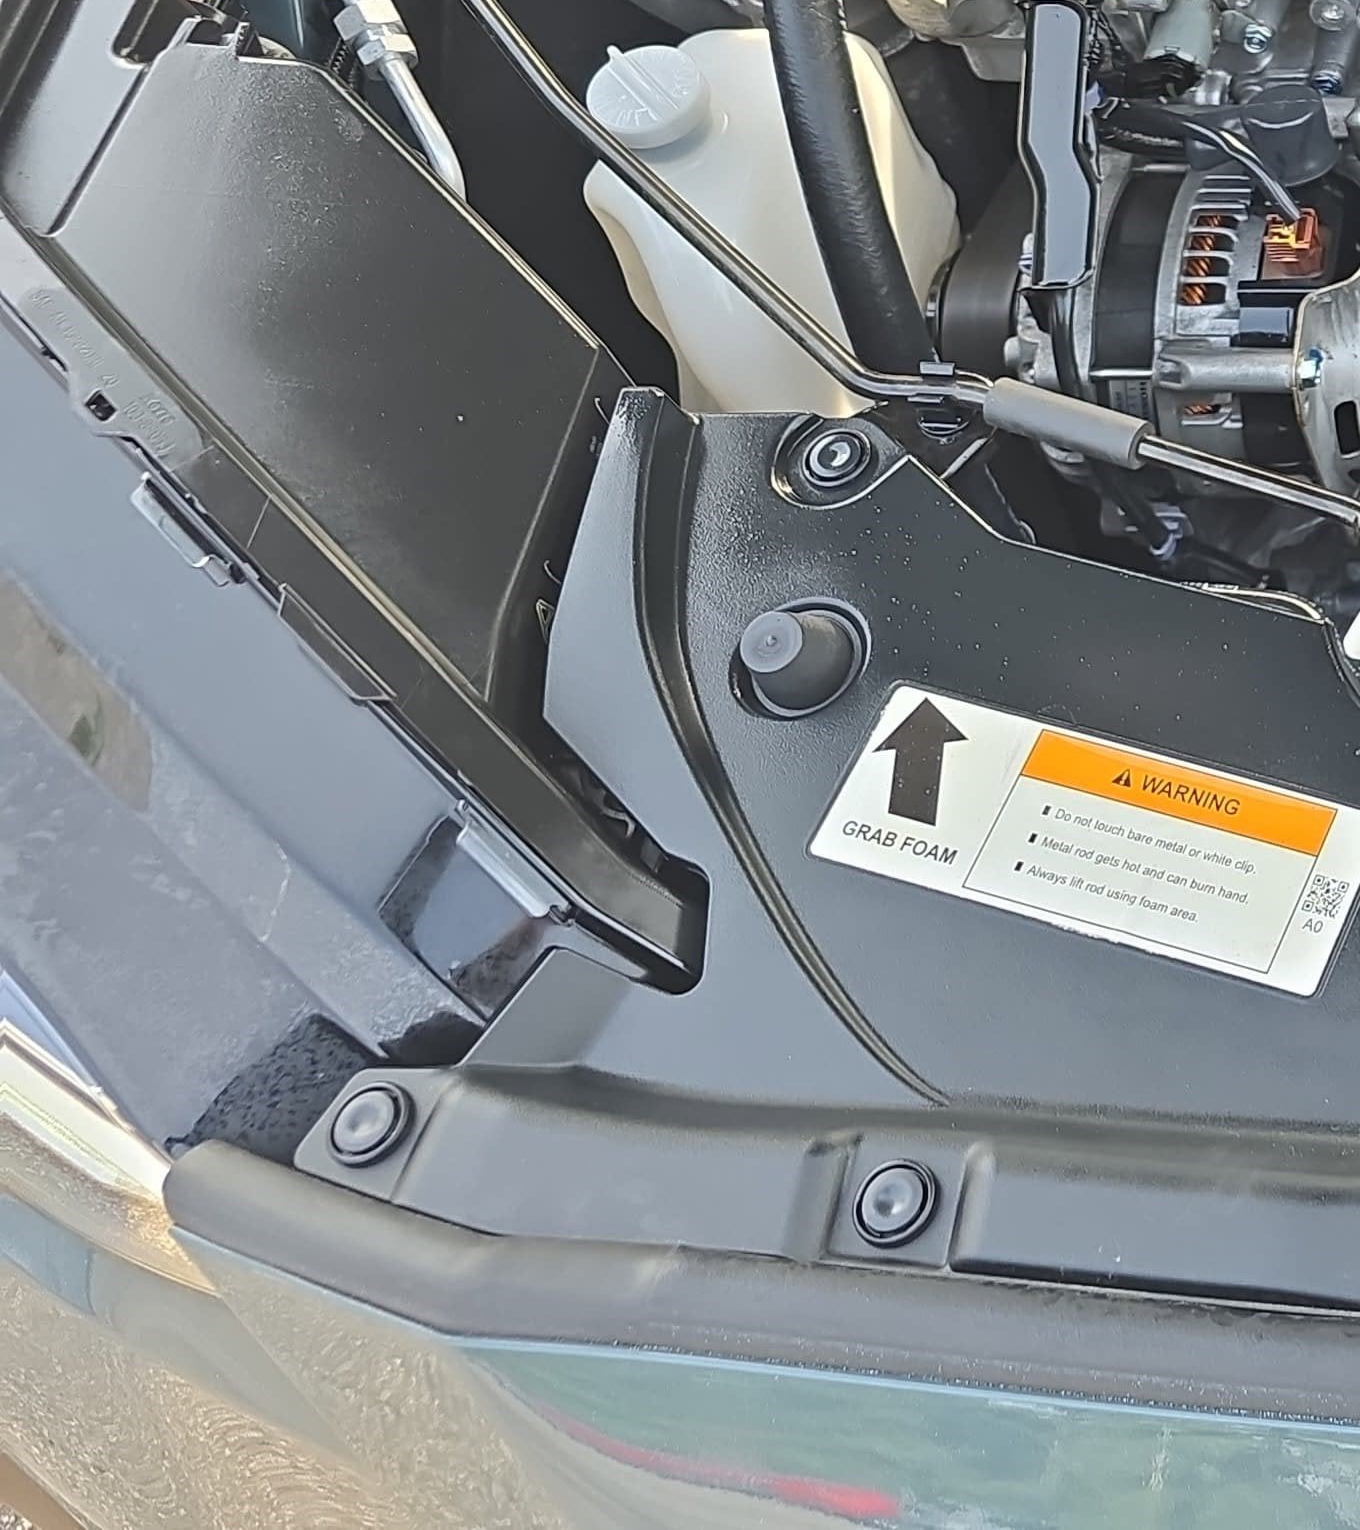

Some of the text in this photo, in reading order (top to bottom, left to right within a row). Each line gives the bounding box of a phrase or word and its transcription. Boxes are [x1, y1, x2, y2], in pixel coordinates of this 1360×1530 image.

[1141, 774, 1241, 816] WARNING
[842, 820, 959, 865] GRAB FOAM
[1055, 808, 1257, 876] Do not touch bare metal or white clip.
[1027, 865, 1200, 923] Always lift rod using foam area.
[1041, 837, 1250, 905] Metal rod gets hot and can burn hand.
[1302, 918, 1324, 934] A0
